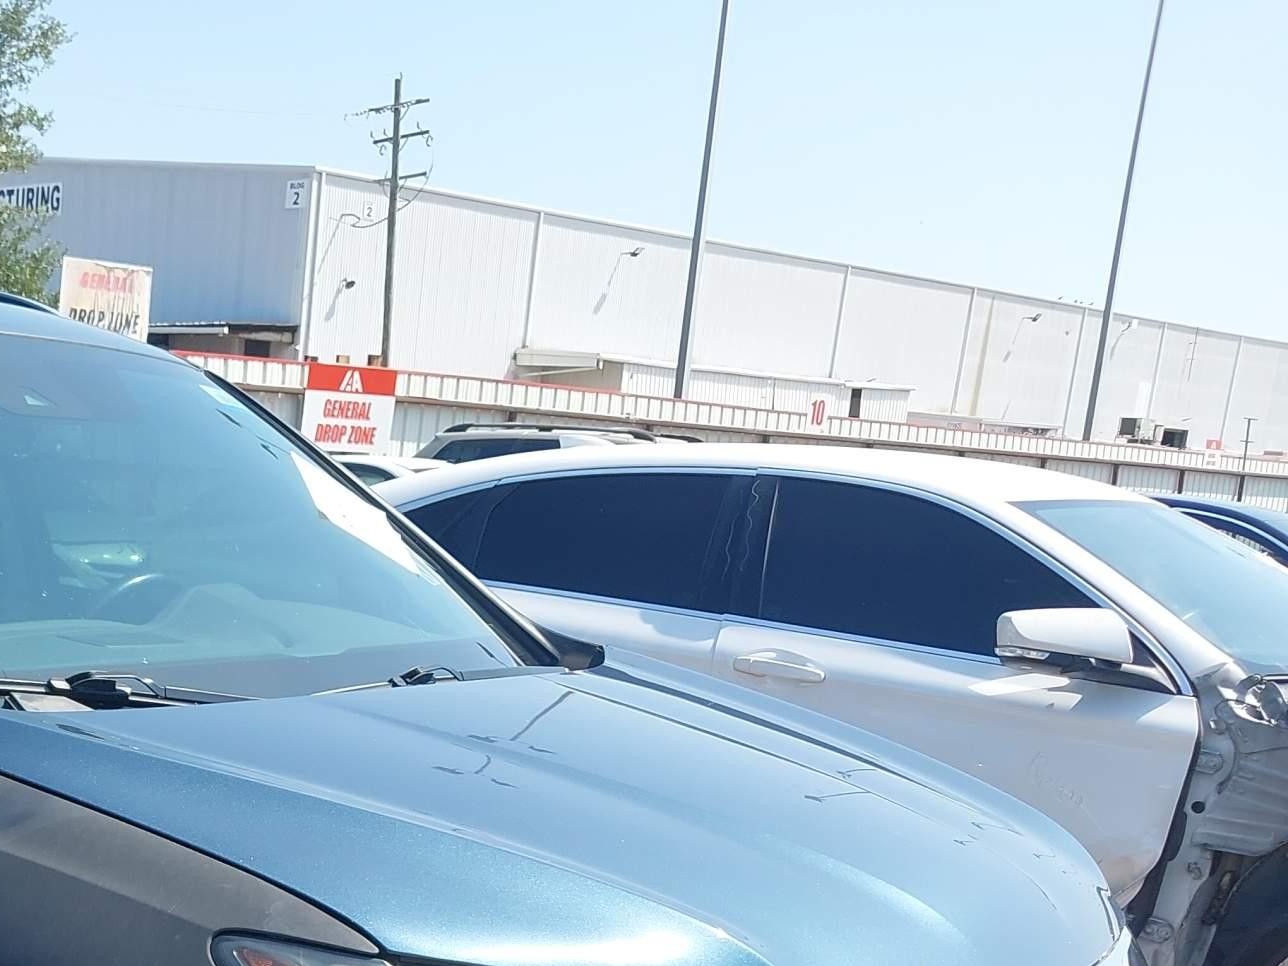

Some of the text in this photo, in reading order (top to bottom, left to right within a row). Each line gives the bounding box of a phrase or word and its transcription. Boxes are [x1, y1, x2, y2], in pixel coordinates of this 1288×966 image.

[292, 191, 300, 206] 2
[69, 307, 105, 328] DROP
[323, 398, 372, 421] GENERAL
[811, 399, 825, 426] 10
[314, 423, 377, 446] DROP ZONE
